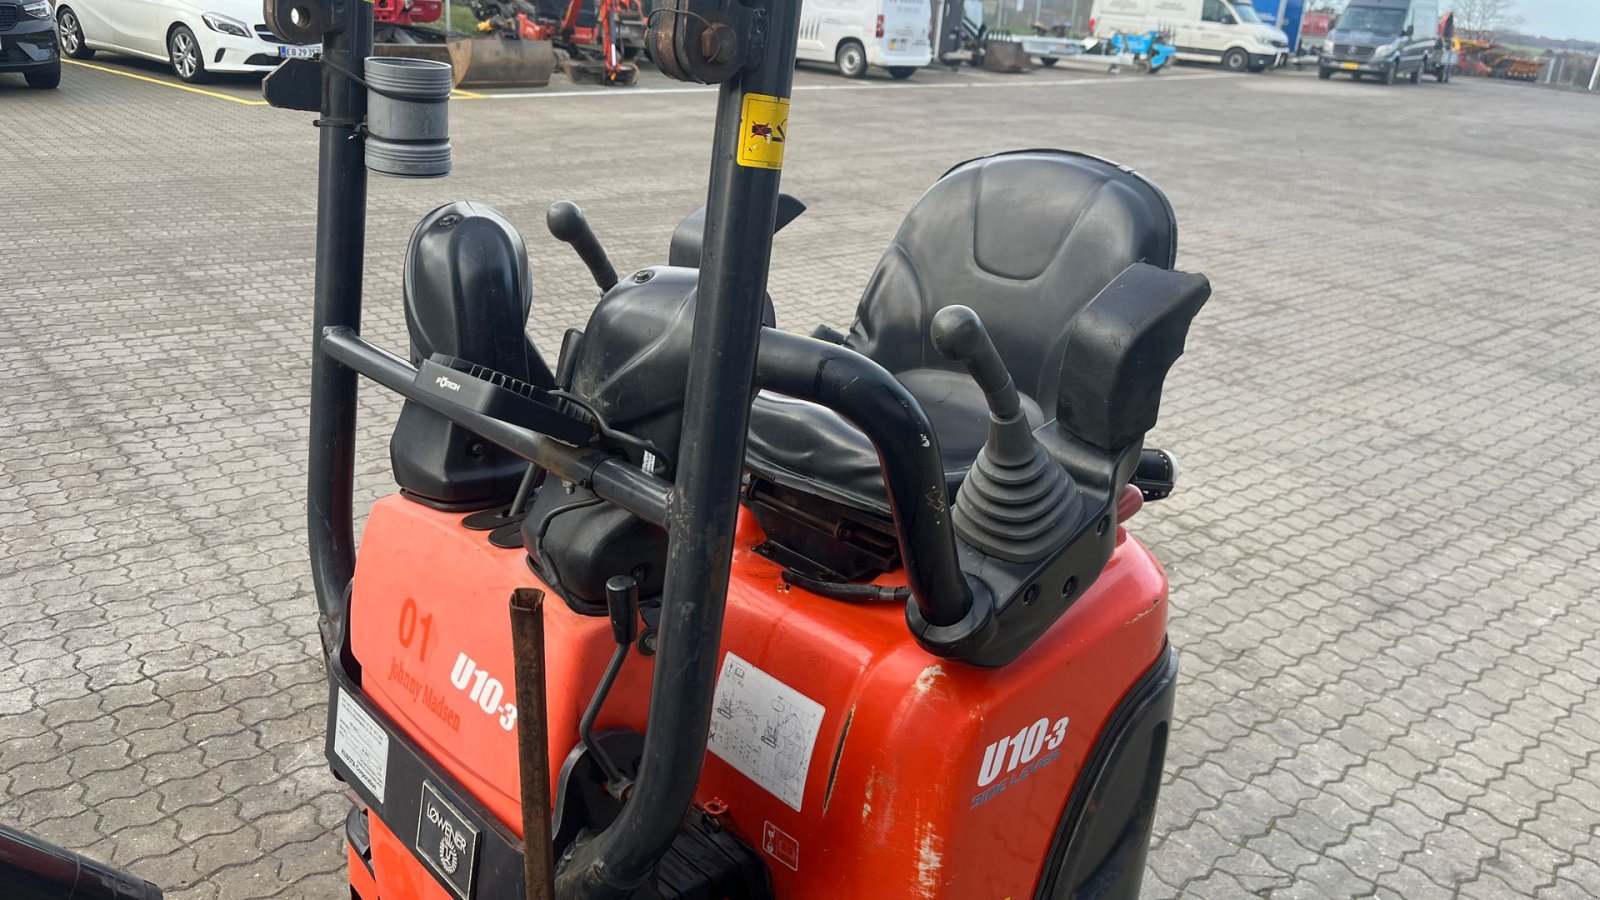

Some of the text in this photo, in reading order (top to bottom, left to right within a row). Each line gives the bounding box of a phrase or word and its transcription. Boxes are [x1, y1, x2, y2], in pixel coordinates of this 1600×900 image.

[398, 597, 433, 662] 01
[422, 684, 460, 733] Madsen
[450, 652, 518, 731] U10-3
[978, 717, 1069, 787] U10-3
[426, 802, 467, 855] LØWENER
